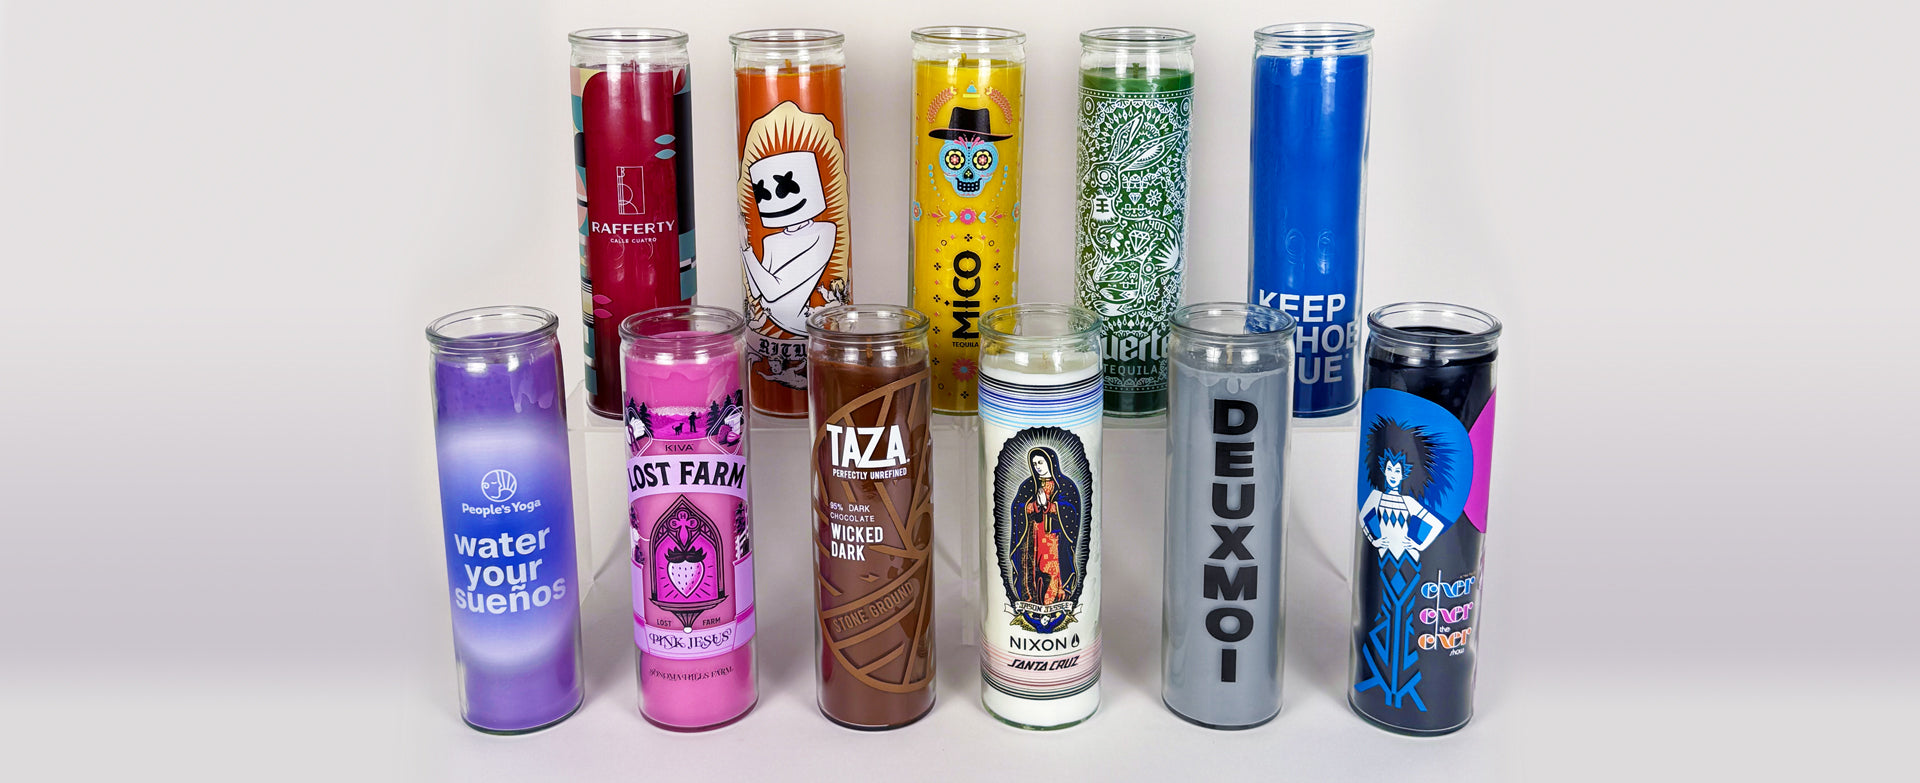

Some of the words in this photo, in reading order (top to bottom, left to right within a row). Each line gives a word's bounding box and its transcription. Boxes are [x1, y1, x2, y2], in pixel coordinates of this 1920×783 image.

[591, 220, 675, 235] RAFFERTY
[952, 250, 981, 340] MICO
[1259, 289, 1346, 323] KEEP
[952, 341, 979, 349] TEQUILA
[1101, 327, 1169, 362] uert
[1295, 320, 1357, 353] HOE
[759, 339, 807, 357] RITU
[1103, 364, 1158, 376] TEQUILA
[1298, 354, 1343, 385] UE
[628, 462, 671, 492] LOST
[680, 462, 745, 489] FARM
[832, 468, 868, 480] PERFECTLY
[870, 467, 908, 479] UNREFINED
[462, 503, 511, 518] People's
[511, 500, 541, 512] Yoga
[830, 501, 844, 511] 95%
[848, 504, 871, 513] DARK
[830, 511, 875, 522] CHOCOLATE
[454, 527, 550, 558] water
[831, 523, 884, 543] WICKED
[1203, 398, 1258, 682] DEUXMOI
[831, 541, 865, 561] DARK
[464, 559, 543, 591] your
[455, 578, 566, 614] sueños
[833, 609, 868, 633] STONE
[869, 581, 914, 618] GROUND
[656, 619, 672, 627] LOST
[702, 617, 721, 626] FARM
[649, 632, 685, 650] PINK
[687, 628, 732, 649] JESUS
[1010, 635, 1067, 651] NIXON
[1007, 659, 1049, 671] SANTA
[1049, 655, 1080, 671] CRUZ
